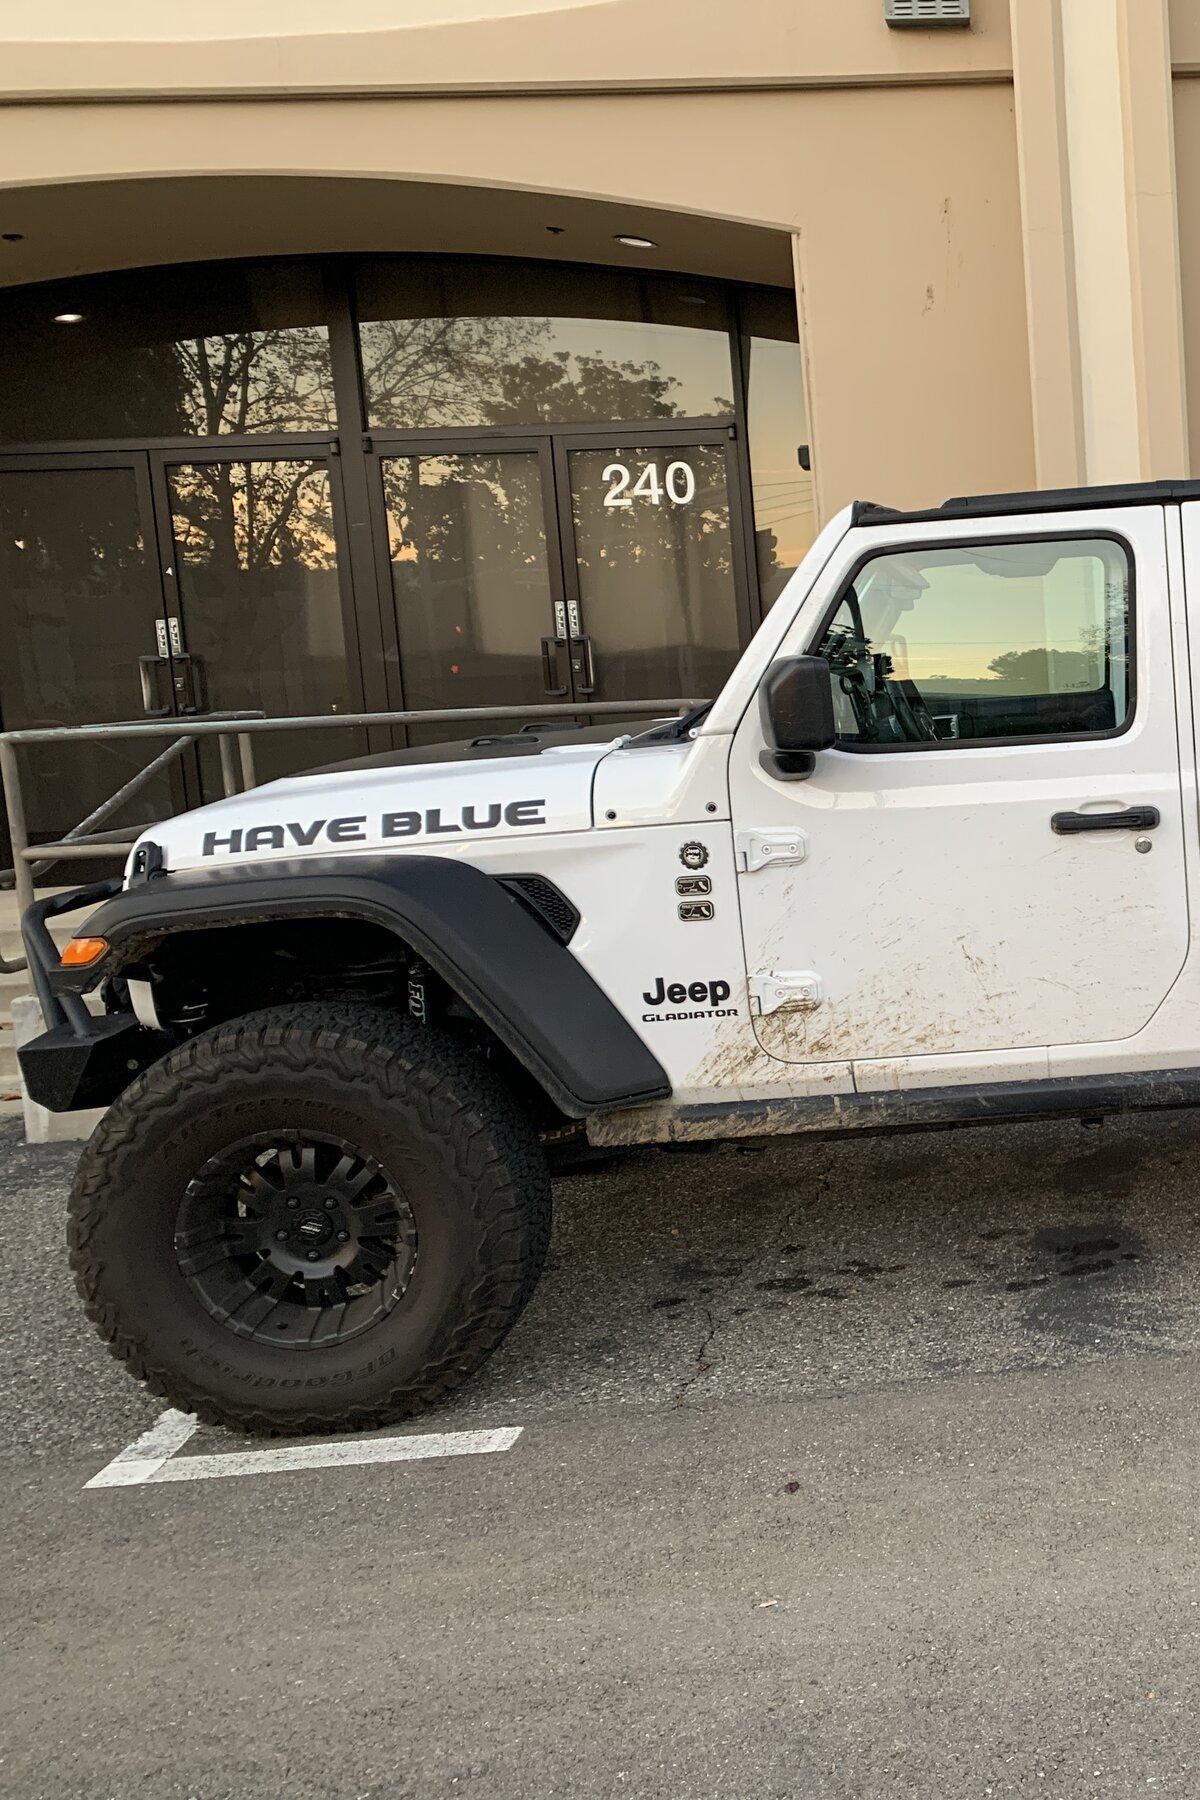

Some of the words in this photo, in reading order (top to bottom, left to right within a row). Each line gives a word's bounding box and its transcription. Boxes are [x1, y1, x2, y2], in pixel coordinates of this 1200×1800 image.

[602, 461, 695, 507] 240
[202, 815, 367, 856] HAVE
[381, 799, 546, 838] BLUE
[407, 981, 426, 1024] FO
[642, 977, 730, 1006] Jeep
[642, 1009, 739, 1022] GLADIATOR
